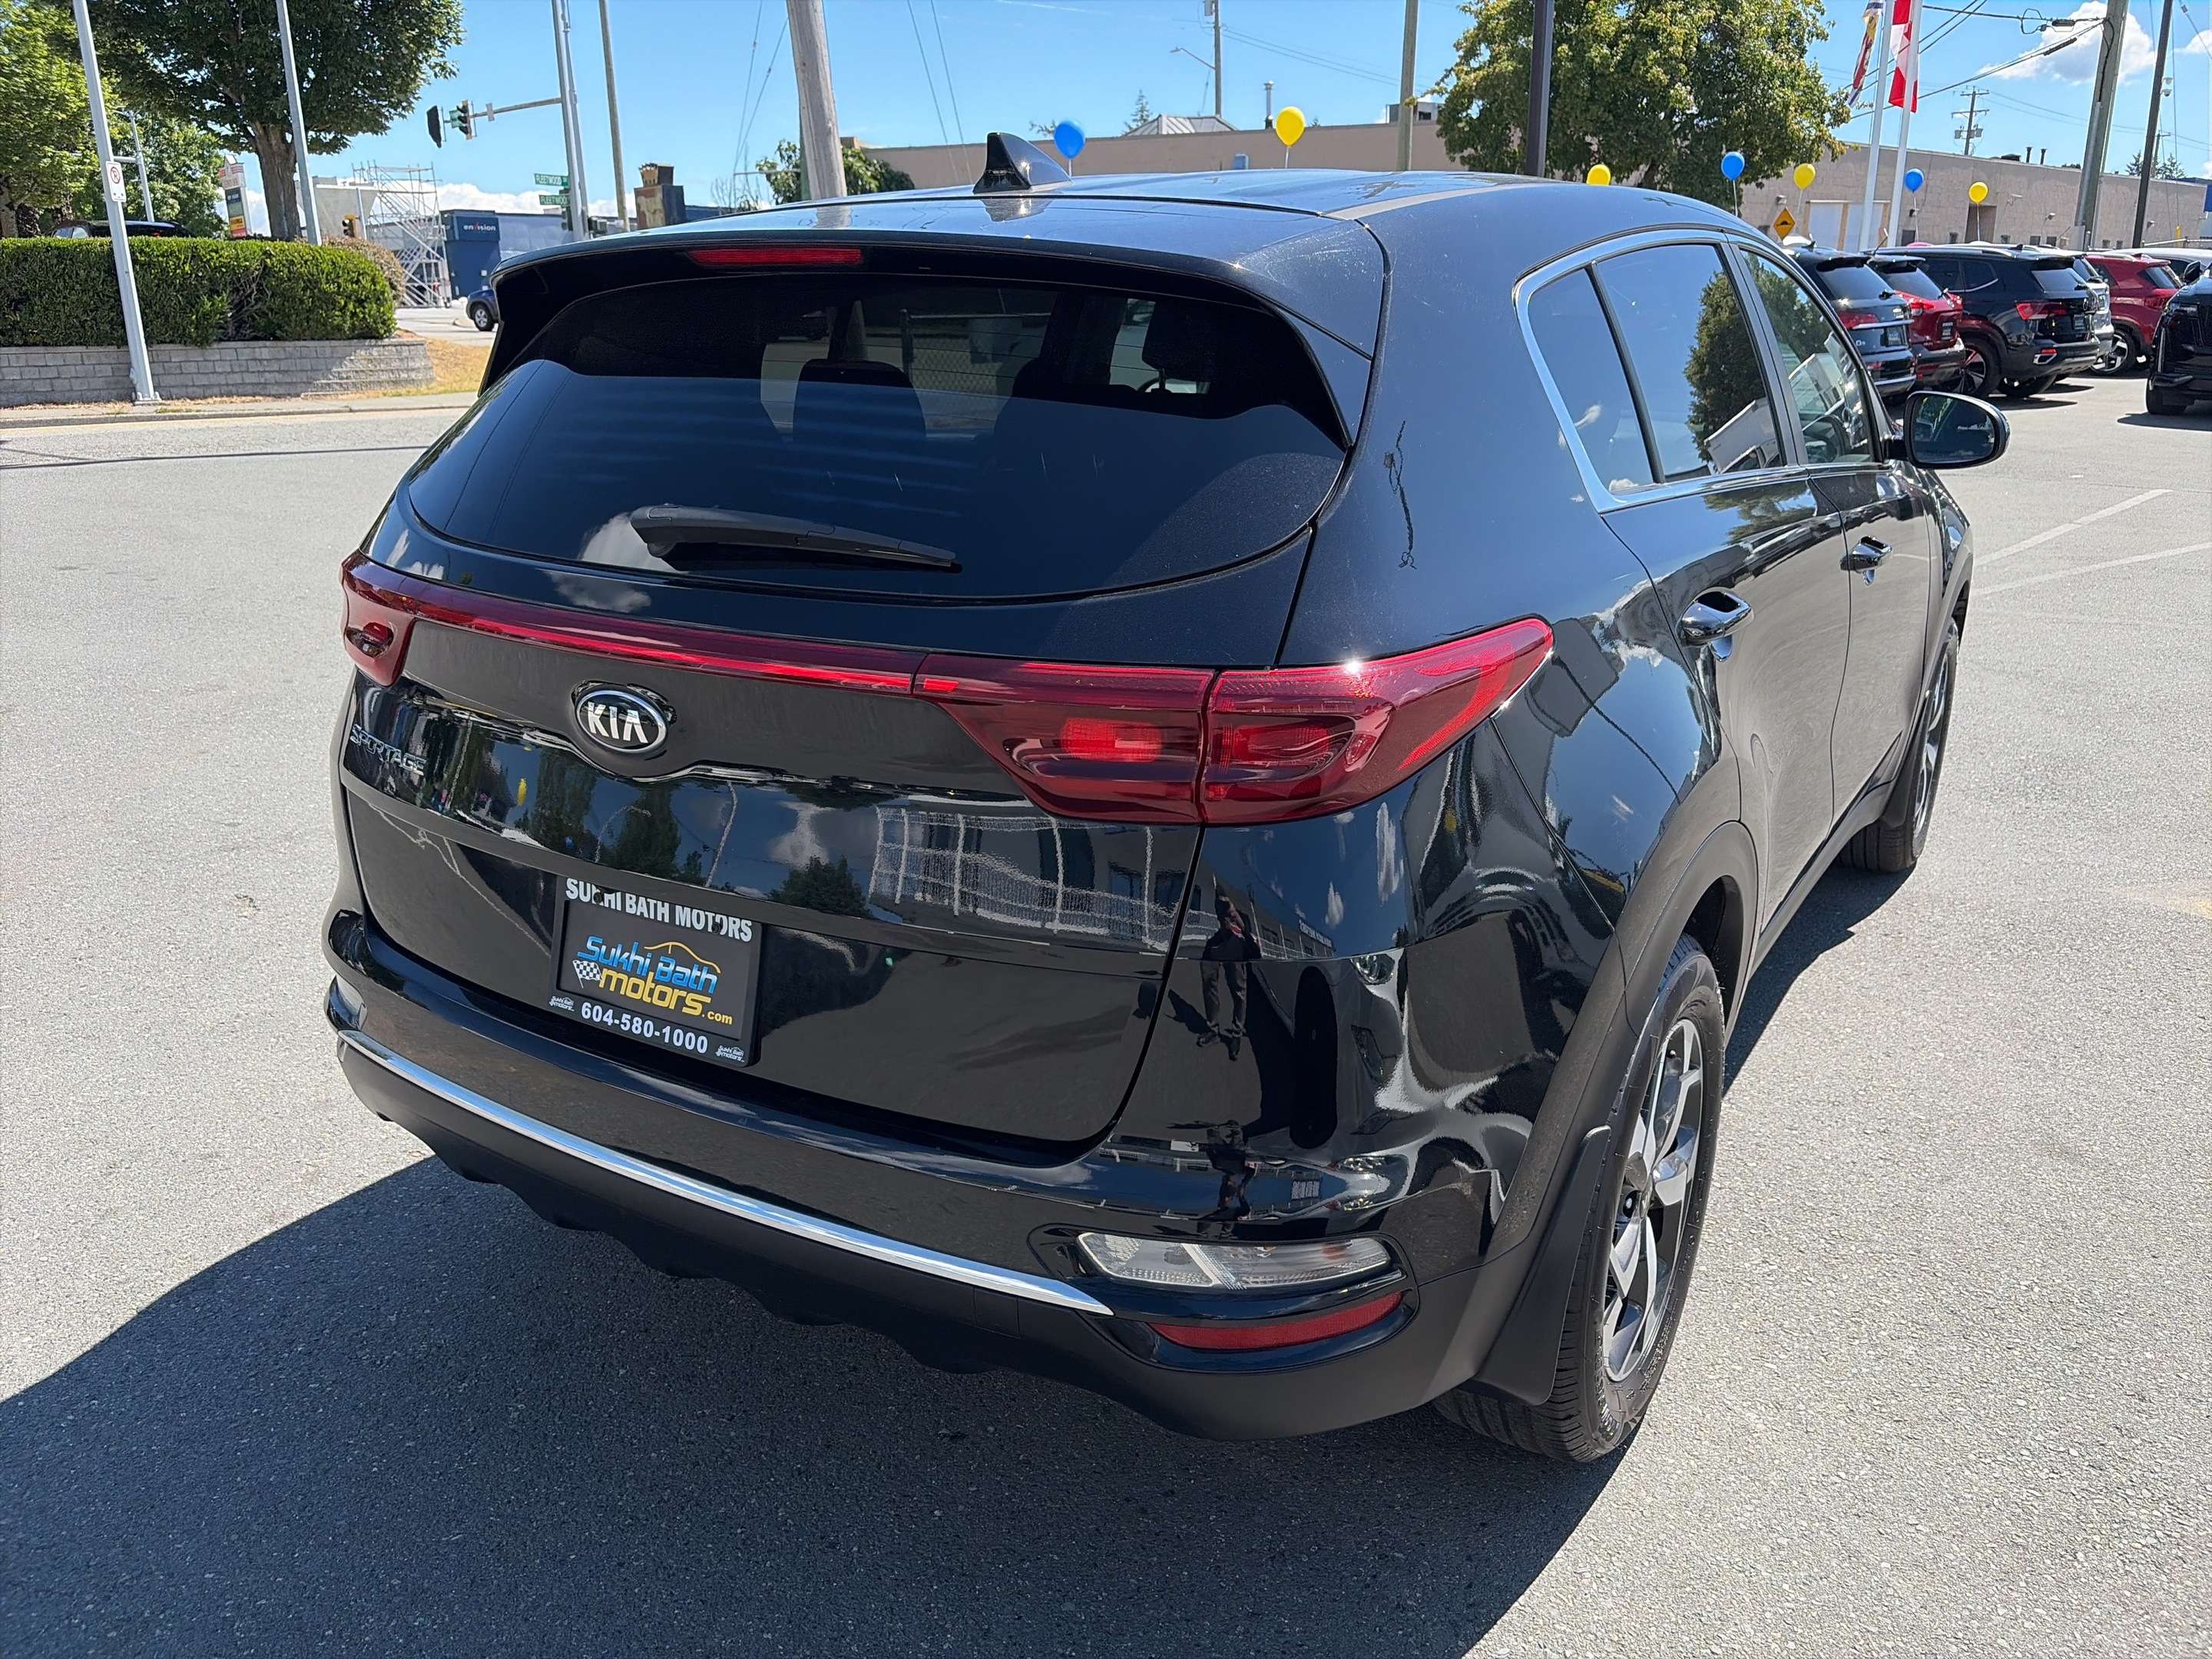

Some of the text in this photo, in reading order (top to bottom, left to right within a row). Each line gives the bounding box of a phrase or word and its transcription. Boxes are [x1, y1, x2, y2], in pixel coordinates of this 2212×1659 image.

[587, 701, 648, 743] KIA
[349, 724, 427, 776] SPORTAGE
[625, 892, 670, 923] BATH
[577, 935, 719, 995] Sukhi Bath
[581, 1001, 708, 1055] 604-580-1000
